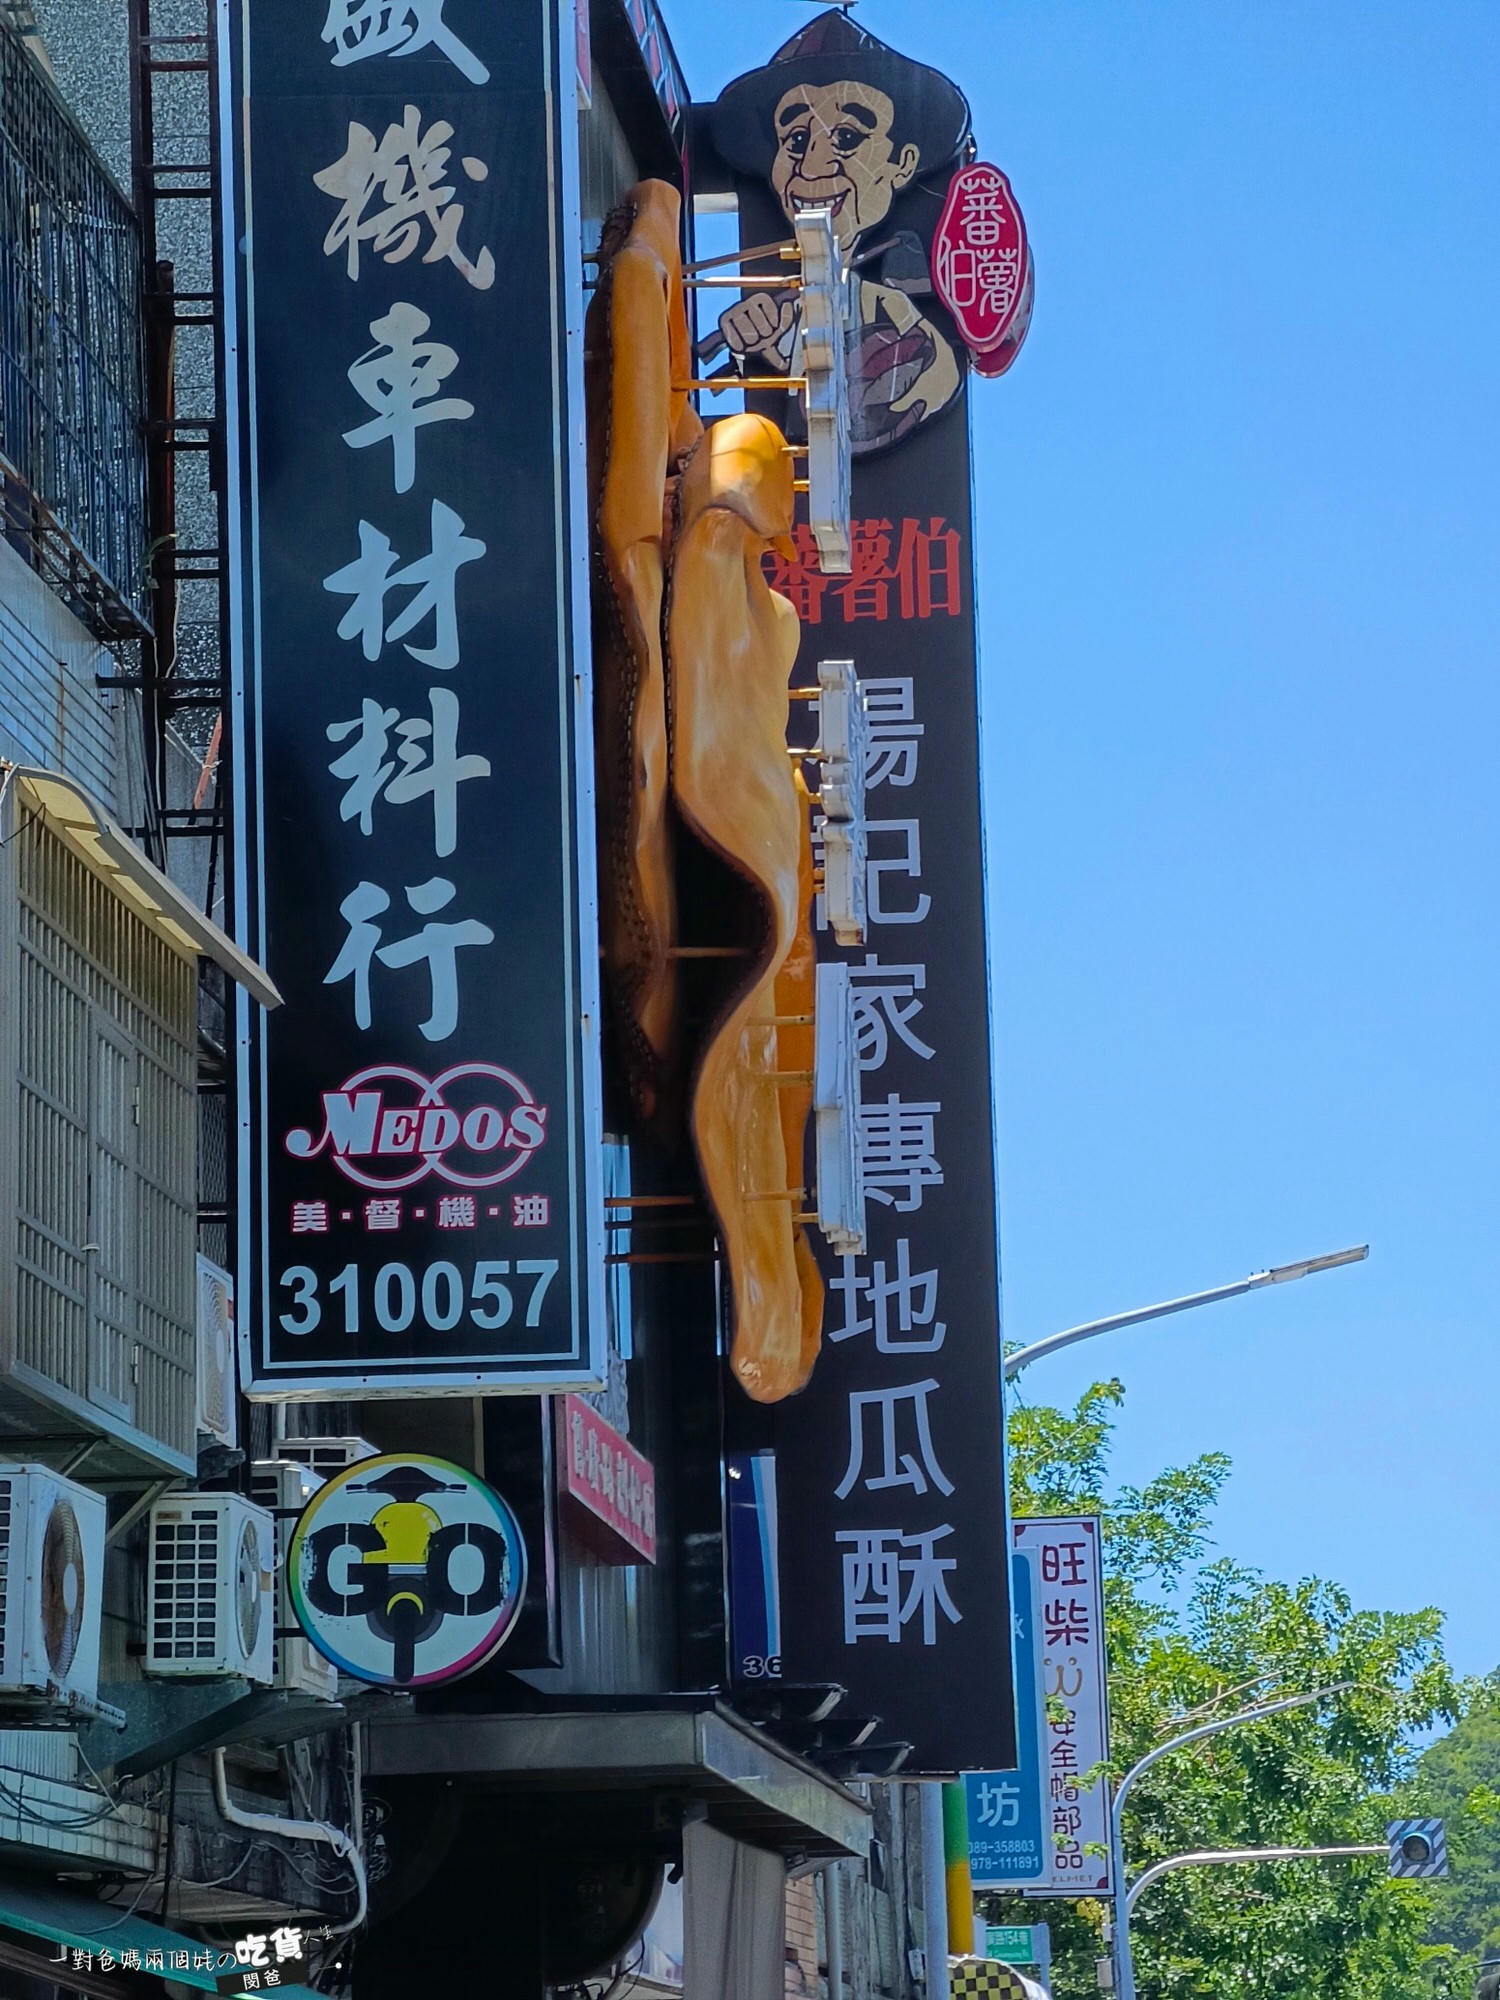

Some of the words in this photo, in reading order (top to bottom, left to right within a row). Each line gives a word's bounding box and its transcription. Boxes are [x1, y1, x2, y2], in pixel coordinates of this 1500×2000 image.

[286, 1092, 547, 1158] MEDOS
[278, 1259, 560, 1335] 310057
[303, 1523, 507, 1617] GO
[1041, 1542, 1089, 1647] 旺柴
[976, 1781, 1020, 1827] 坊
